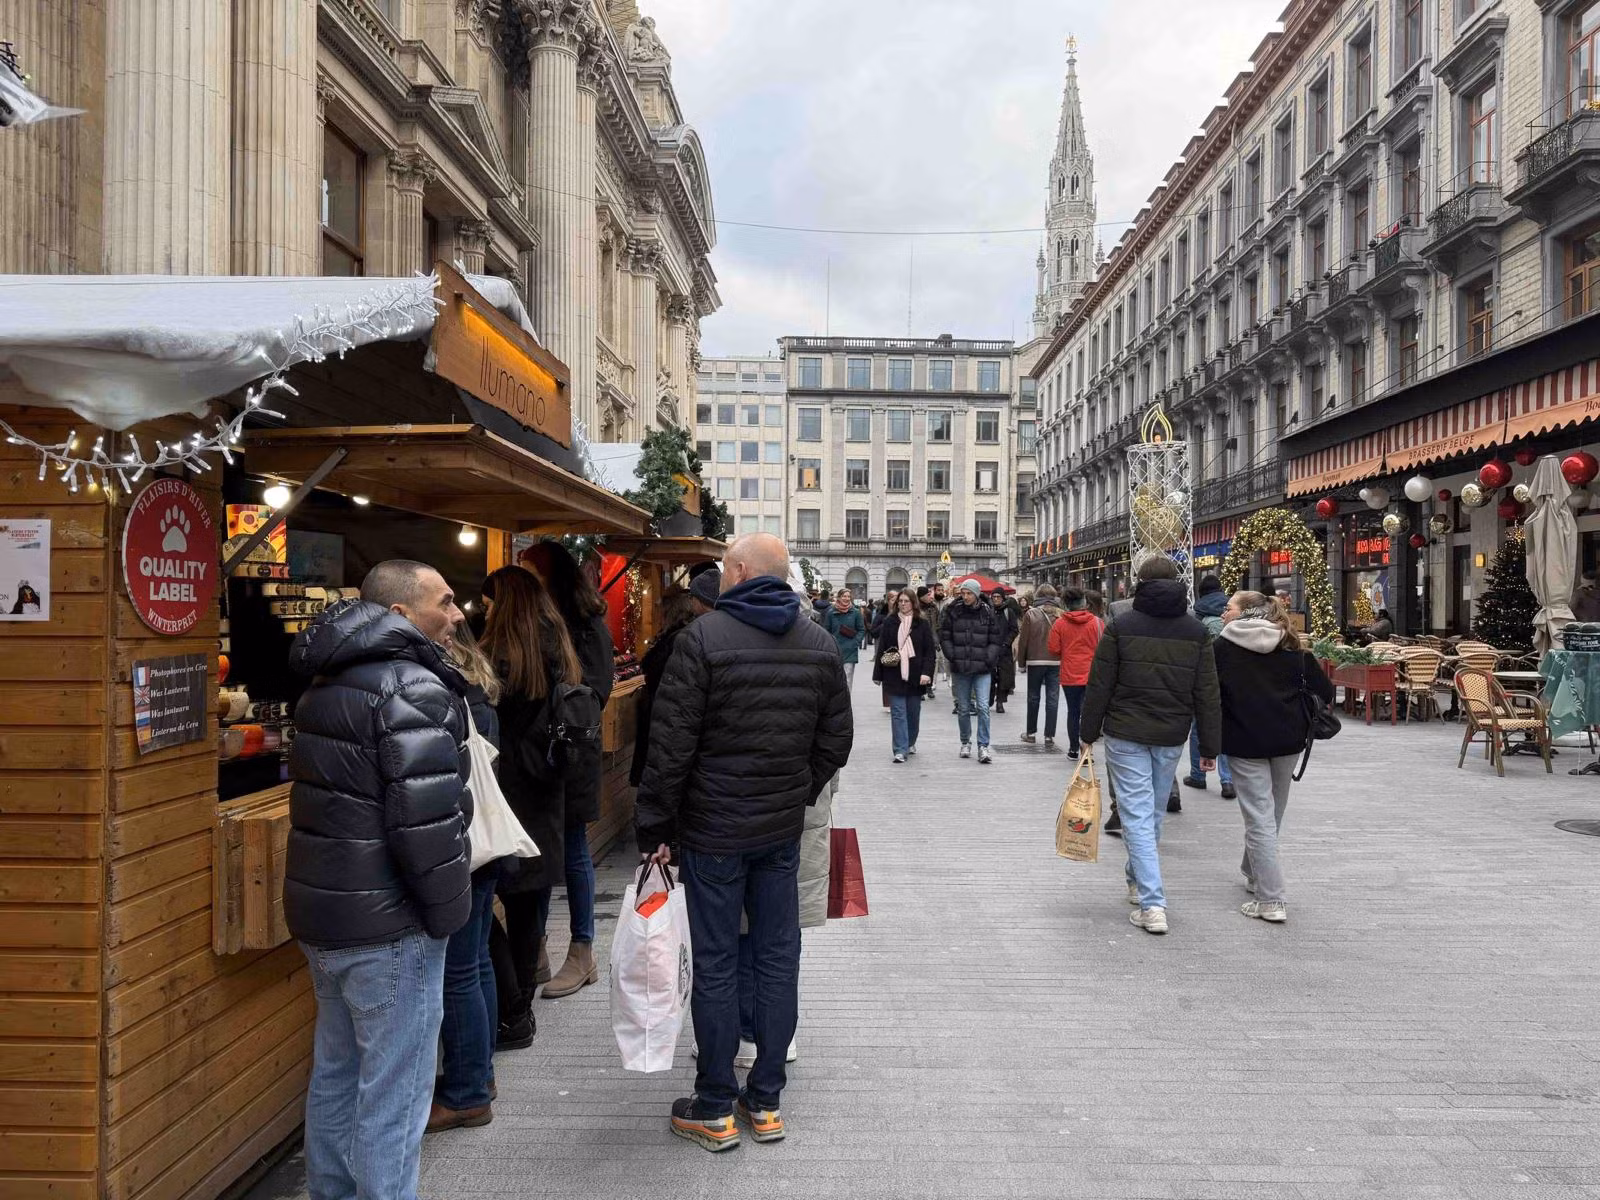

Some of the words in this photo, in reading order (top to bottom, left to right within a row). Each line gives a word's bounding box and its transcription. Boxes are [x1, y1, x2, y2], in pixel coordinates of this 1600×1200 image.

[1408, 444, 1447, 460] BRASSERIE
[1449, 434, 1475, 449] BELGE
[138, 481, 180, 515] PLAISIRS
[182, 484, 212, 529] D'HIVER
[140, 556, 207, 580] QUALITY
[150, 581, 197, 602] LABEL
[147, 607, 197, 632] WINTERPRET
[177, 722, 185, 731] de
[186, 721, 199, 729] Cera
